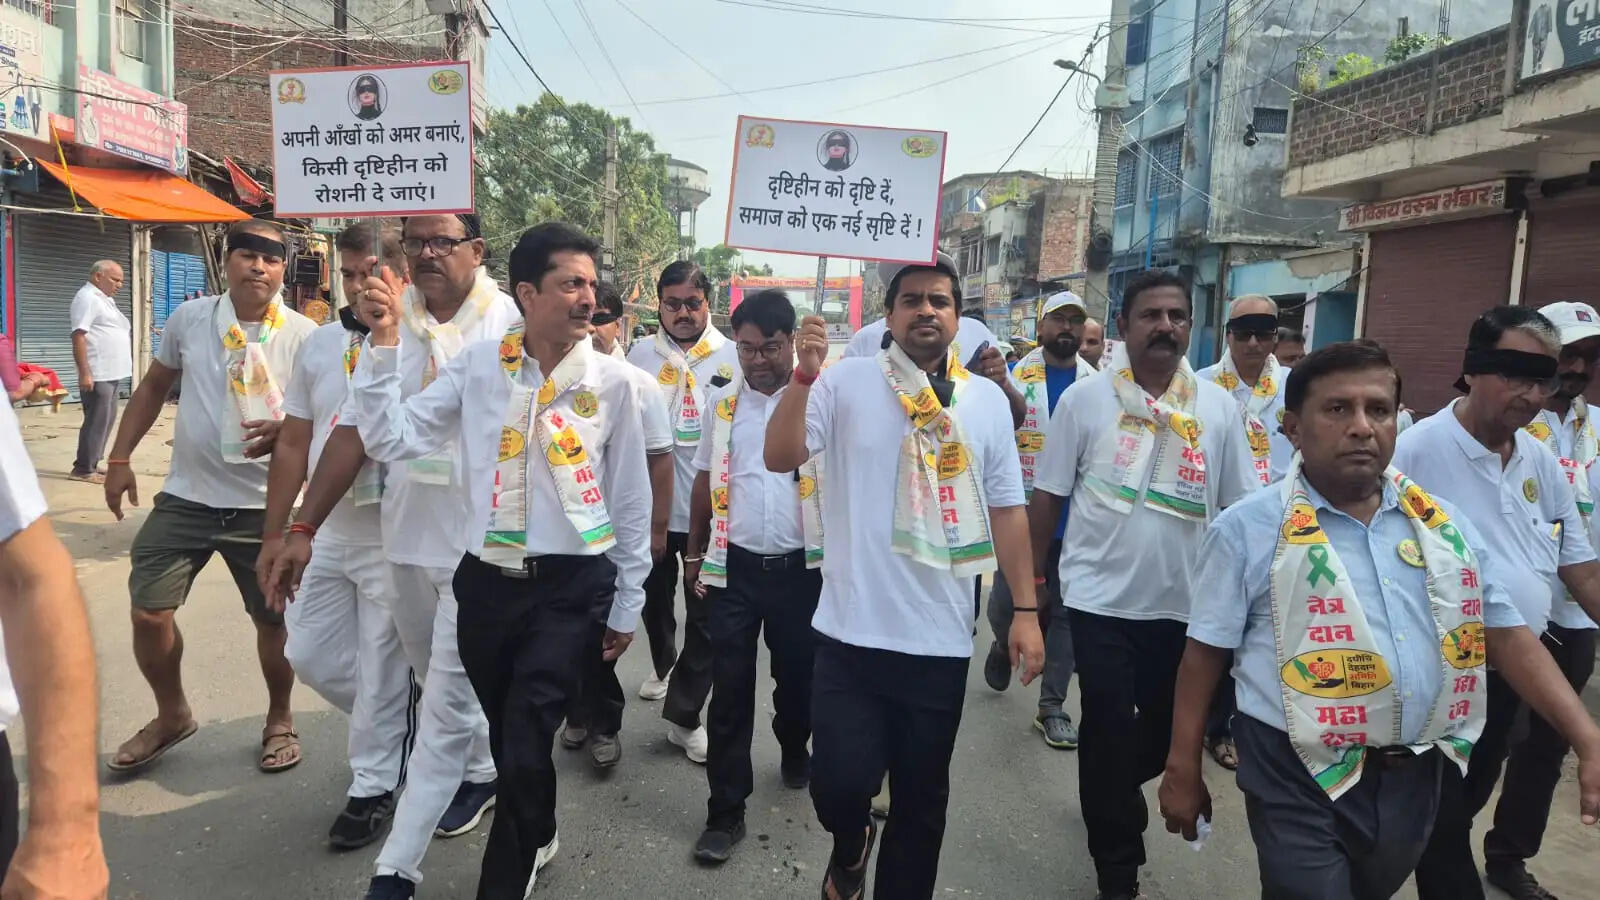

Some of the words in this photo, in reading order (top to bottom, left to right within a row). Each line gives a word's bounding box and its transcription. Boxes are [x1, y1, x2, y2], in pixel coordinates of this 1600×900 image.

[281, 124, 320, 148] अपनी
[324, 122, 362, 146] आँखों
[366, 122, 384, 145] को
[389, 126, 421, 144] अमर
[425, 120, 465, 144] बनाएं,
[302, 155, 349, 177] किसी
[353, 152, 418, 180] दृष्टिहीन
[423, 152, 449, 173] को
[315, 182, 366, 204] रोशनी
[371, 182, 385, 202] दे
[768, 170, 822, 200] दृष्टिहीन
[824, 175, 845, 199] को
[849, 176, 877, 206] दृष्टि
[880, 178, 895, 206] दें,
[739, 206, 784, 227] समाज
[787, 205, 808, 229] को
[812, 212, 838, 233] एक
[841, 210, 864, 237] नई
[866, 211, 897, 241] सृष्टि
[900, 213, 913, 239] दें
[916, 217, 923, 238] !
[1346, 203, 1360, 226] श्री
[1306, 595, 1347, 615] नेत्र
[1306, 624, 1356, 643] दान
[1350, 681, 1376, 690] बिहार
[1315, 704, 1368, 726] महा
